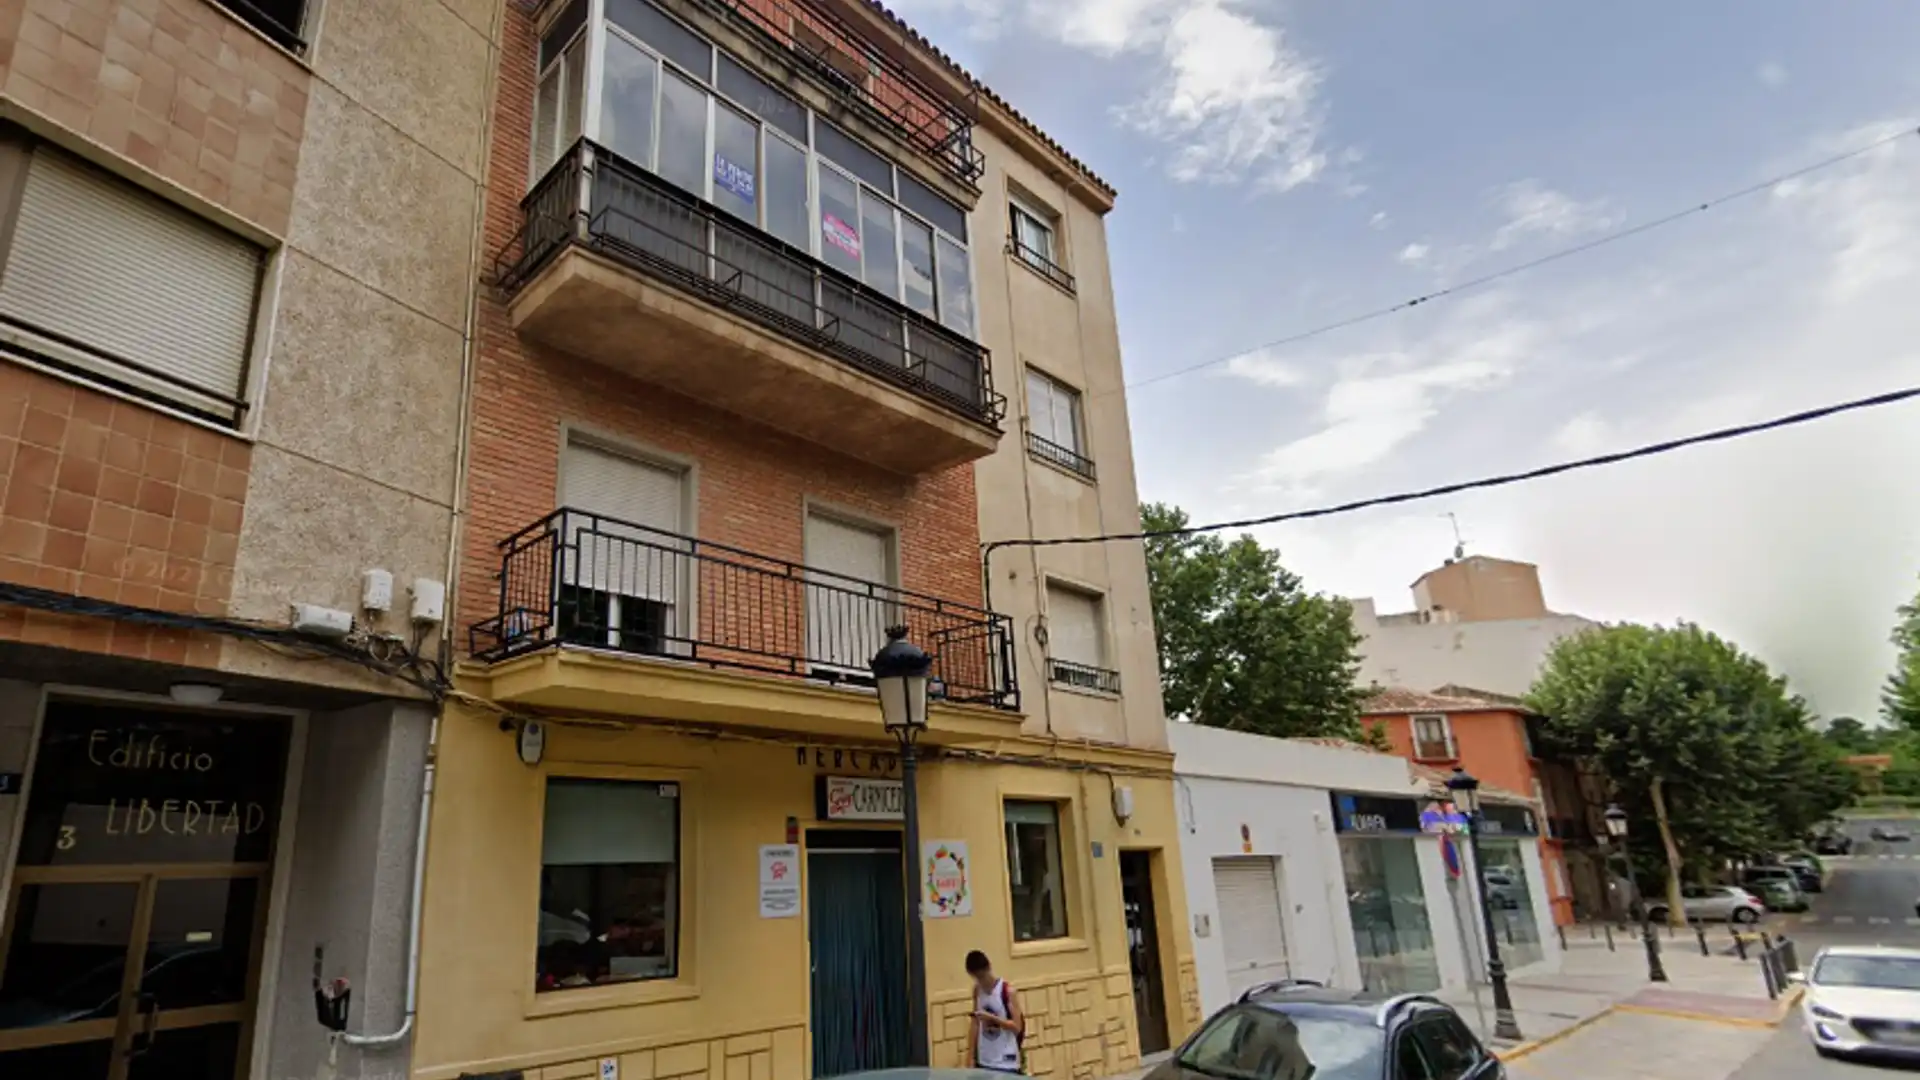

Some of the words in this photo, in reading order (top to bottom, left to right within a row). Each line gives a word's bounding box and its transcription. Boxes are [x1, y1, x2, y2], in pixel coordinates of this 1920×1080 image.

[88, 729, 213, 771] Edificio
[797, 746, 897, 772] MERCAD
[852, 784, 903, 812] CARNICE
[106, 798, 265, 835] LIBERTAD
[56, 825, 77, 850] 3
